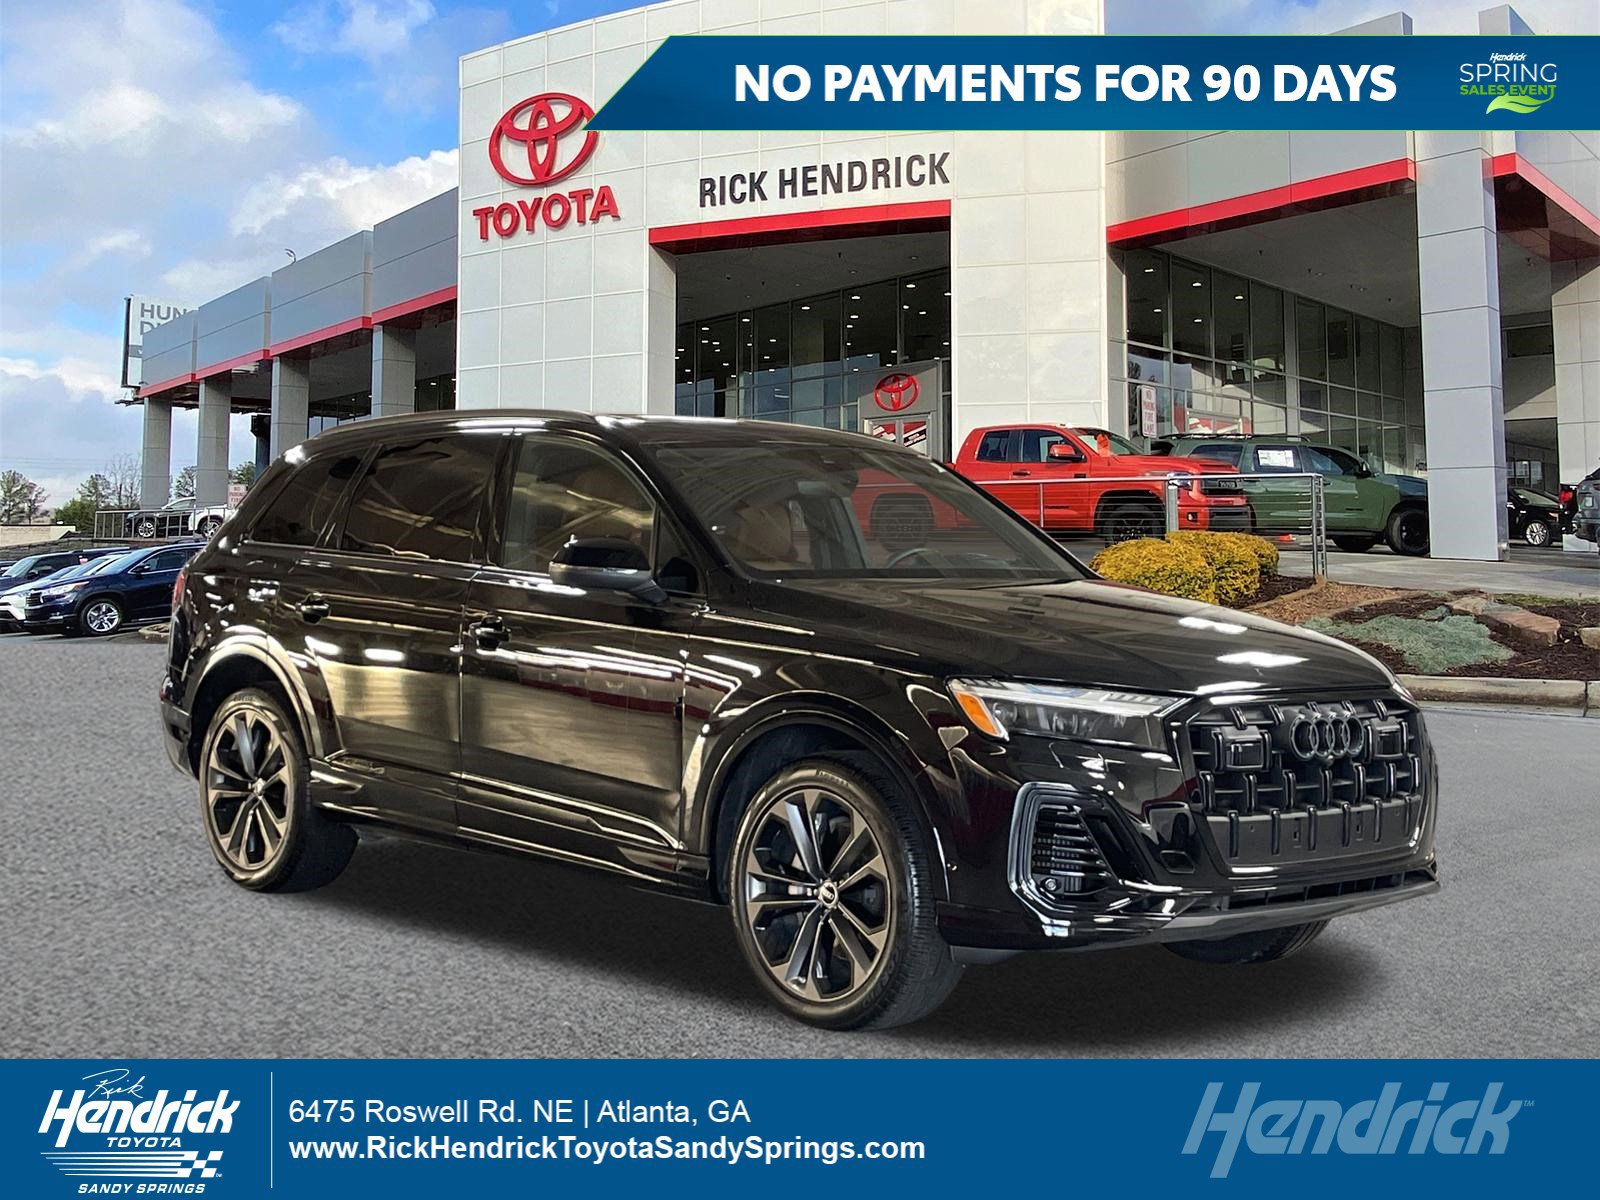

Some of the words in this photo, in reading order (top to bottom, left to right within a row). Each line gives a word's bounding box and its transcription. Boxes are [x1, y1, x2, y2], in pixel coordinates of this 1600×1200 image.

[699, 171, 768, 208] RICK
[779, 152, 950, 199] HENDRICK
[473, 185, 620, 240] TOYOTA
